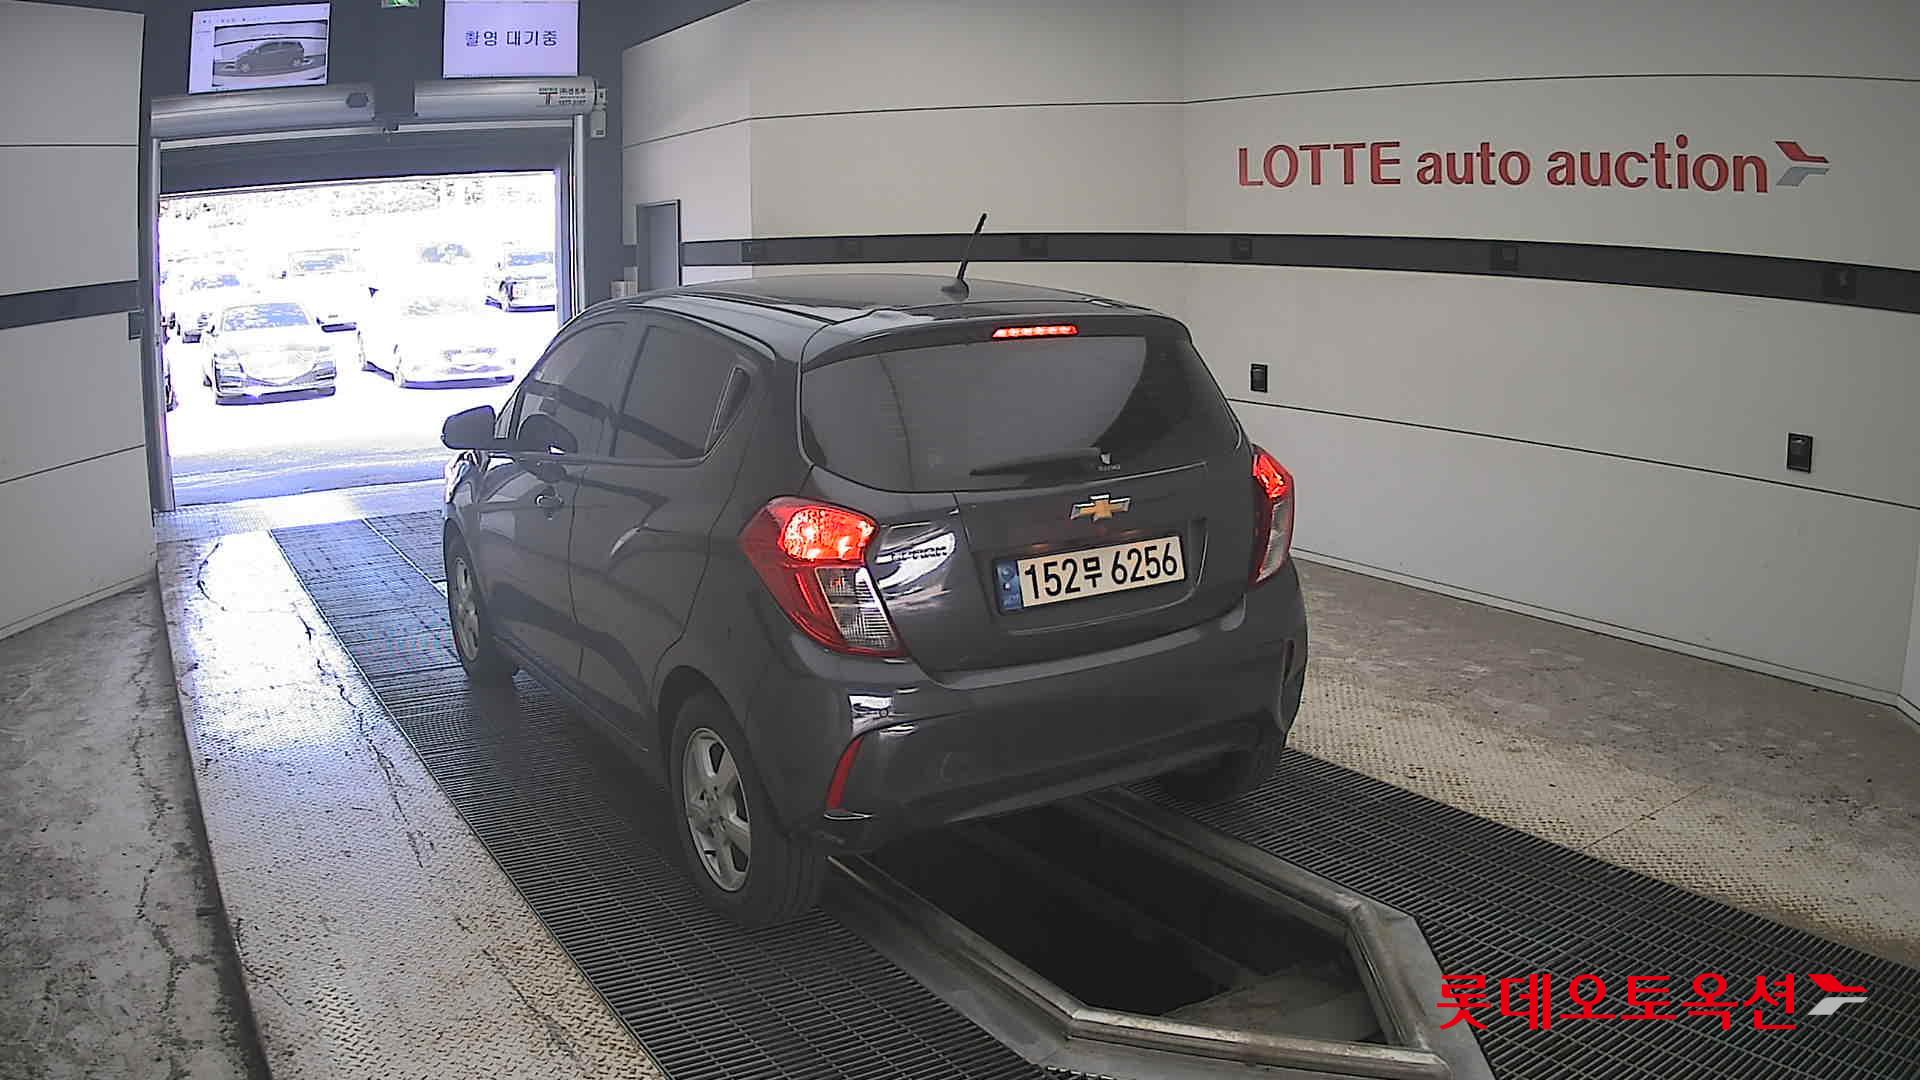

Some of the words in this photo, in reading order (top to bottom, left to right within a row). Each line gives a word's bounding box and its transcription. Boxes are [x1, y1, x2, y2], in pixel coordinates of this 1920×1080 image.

[506, 30, 558, 47] 대기중
[1239, 142, 1400, 186] LOTTE
[1418, 143, 1533, 184] auto
[1547, 134, 1767, 191] auction
[1024, 557, 1103, 600] 152무
[1111, 542, 1178, 585] 6256
